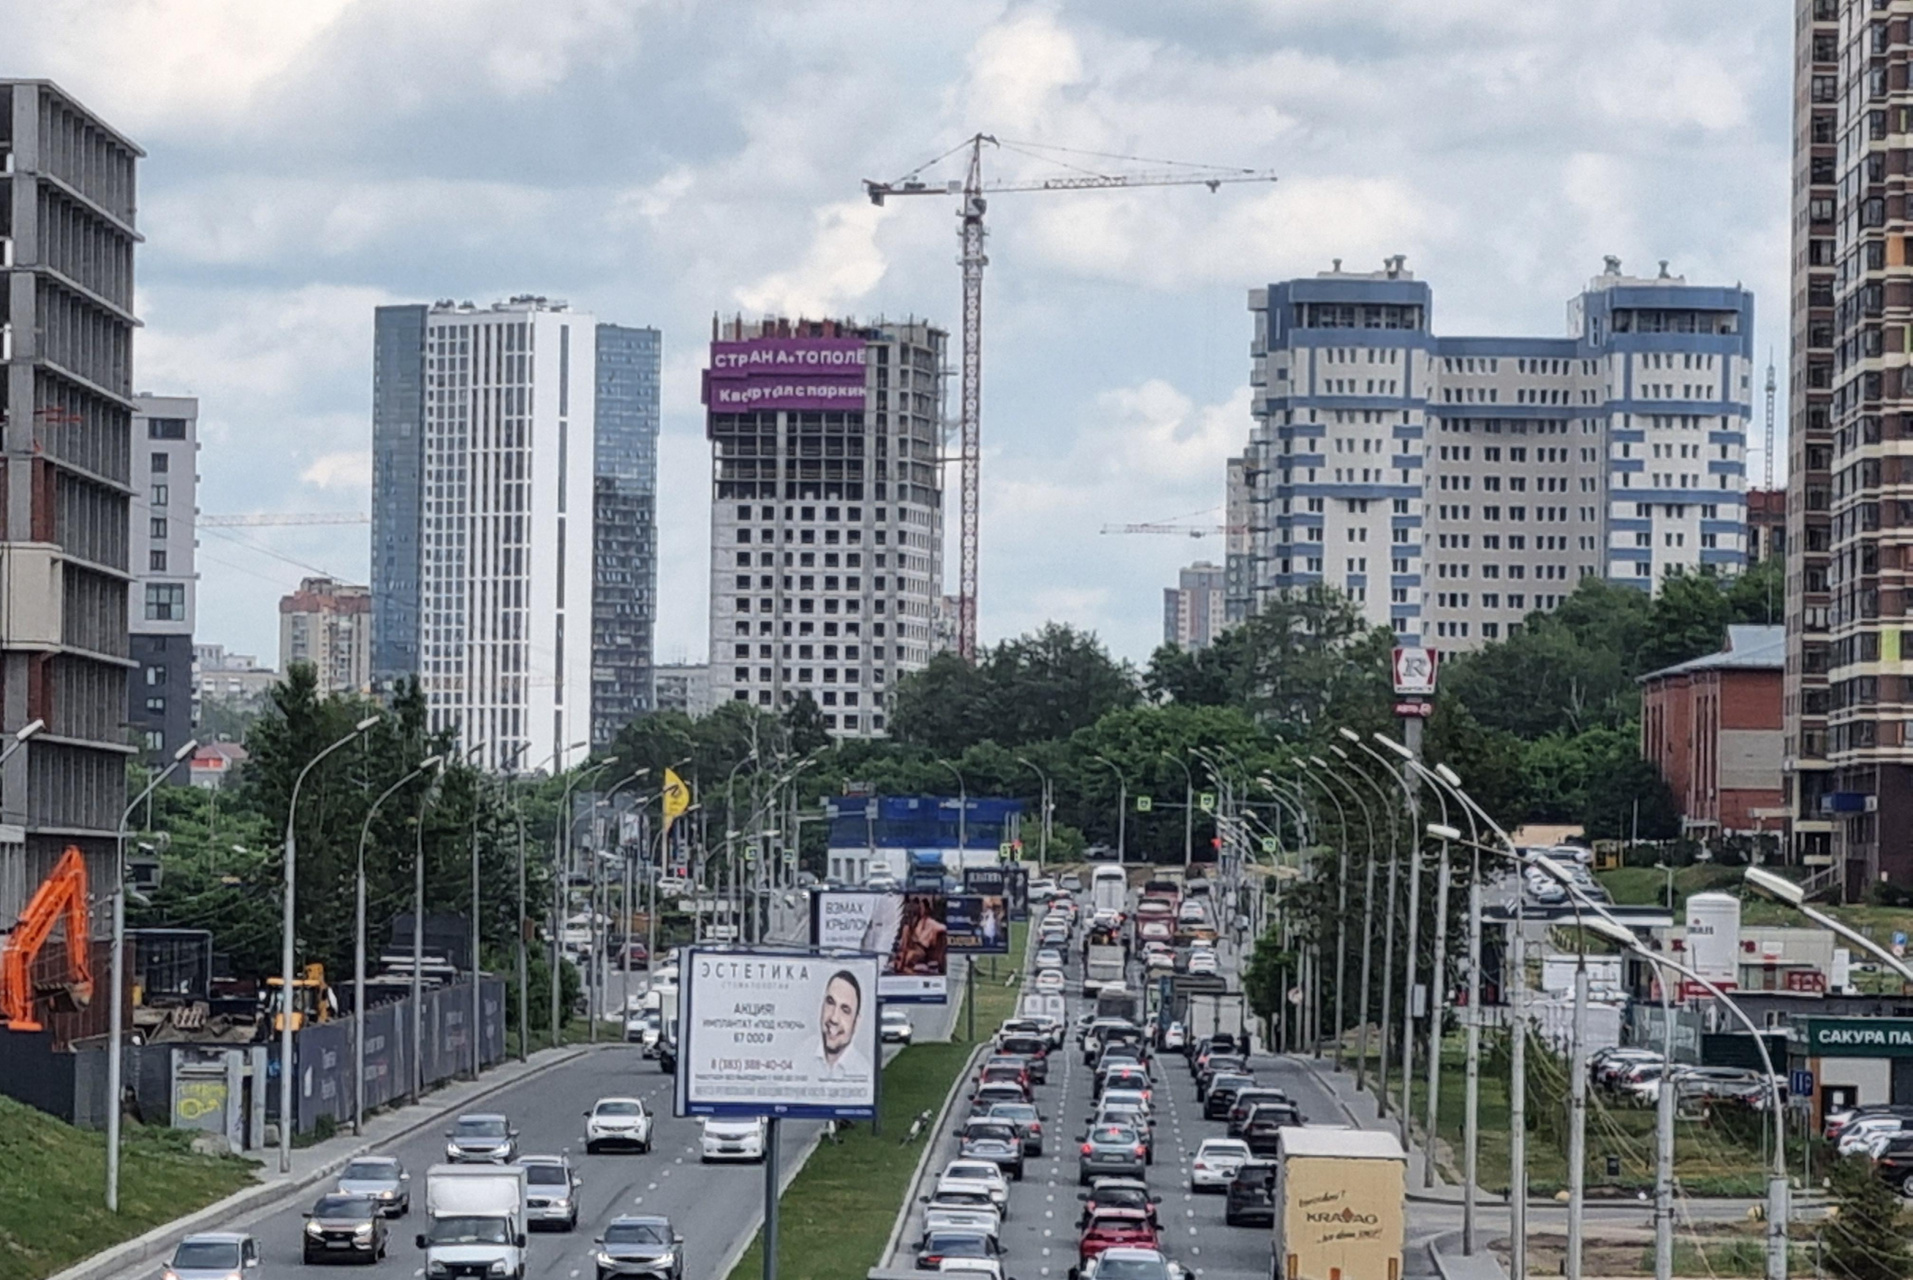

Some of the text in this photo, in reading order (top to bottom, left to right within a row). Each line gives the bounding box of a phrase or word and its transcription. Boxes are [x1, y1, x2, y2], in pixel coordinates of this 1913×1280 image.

[701, 962, 809, 980] ЭСТЕТИКА
[1818, 1029, 1913, 1045] САКУРА ПА
